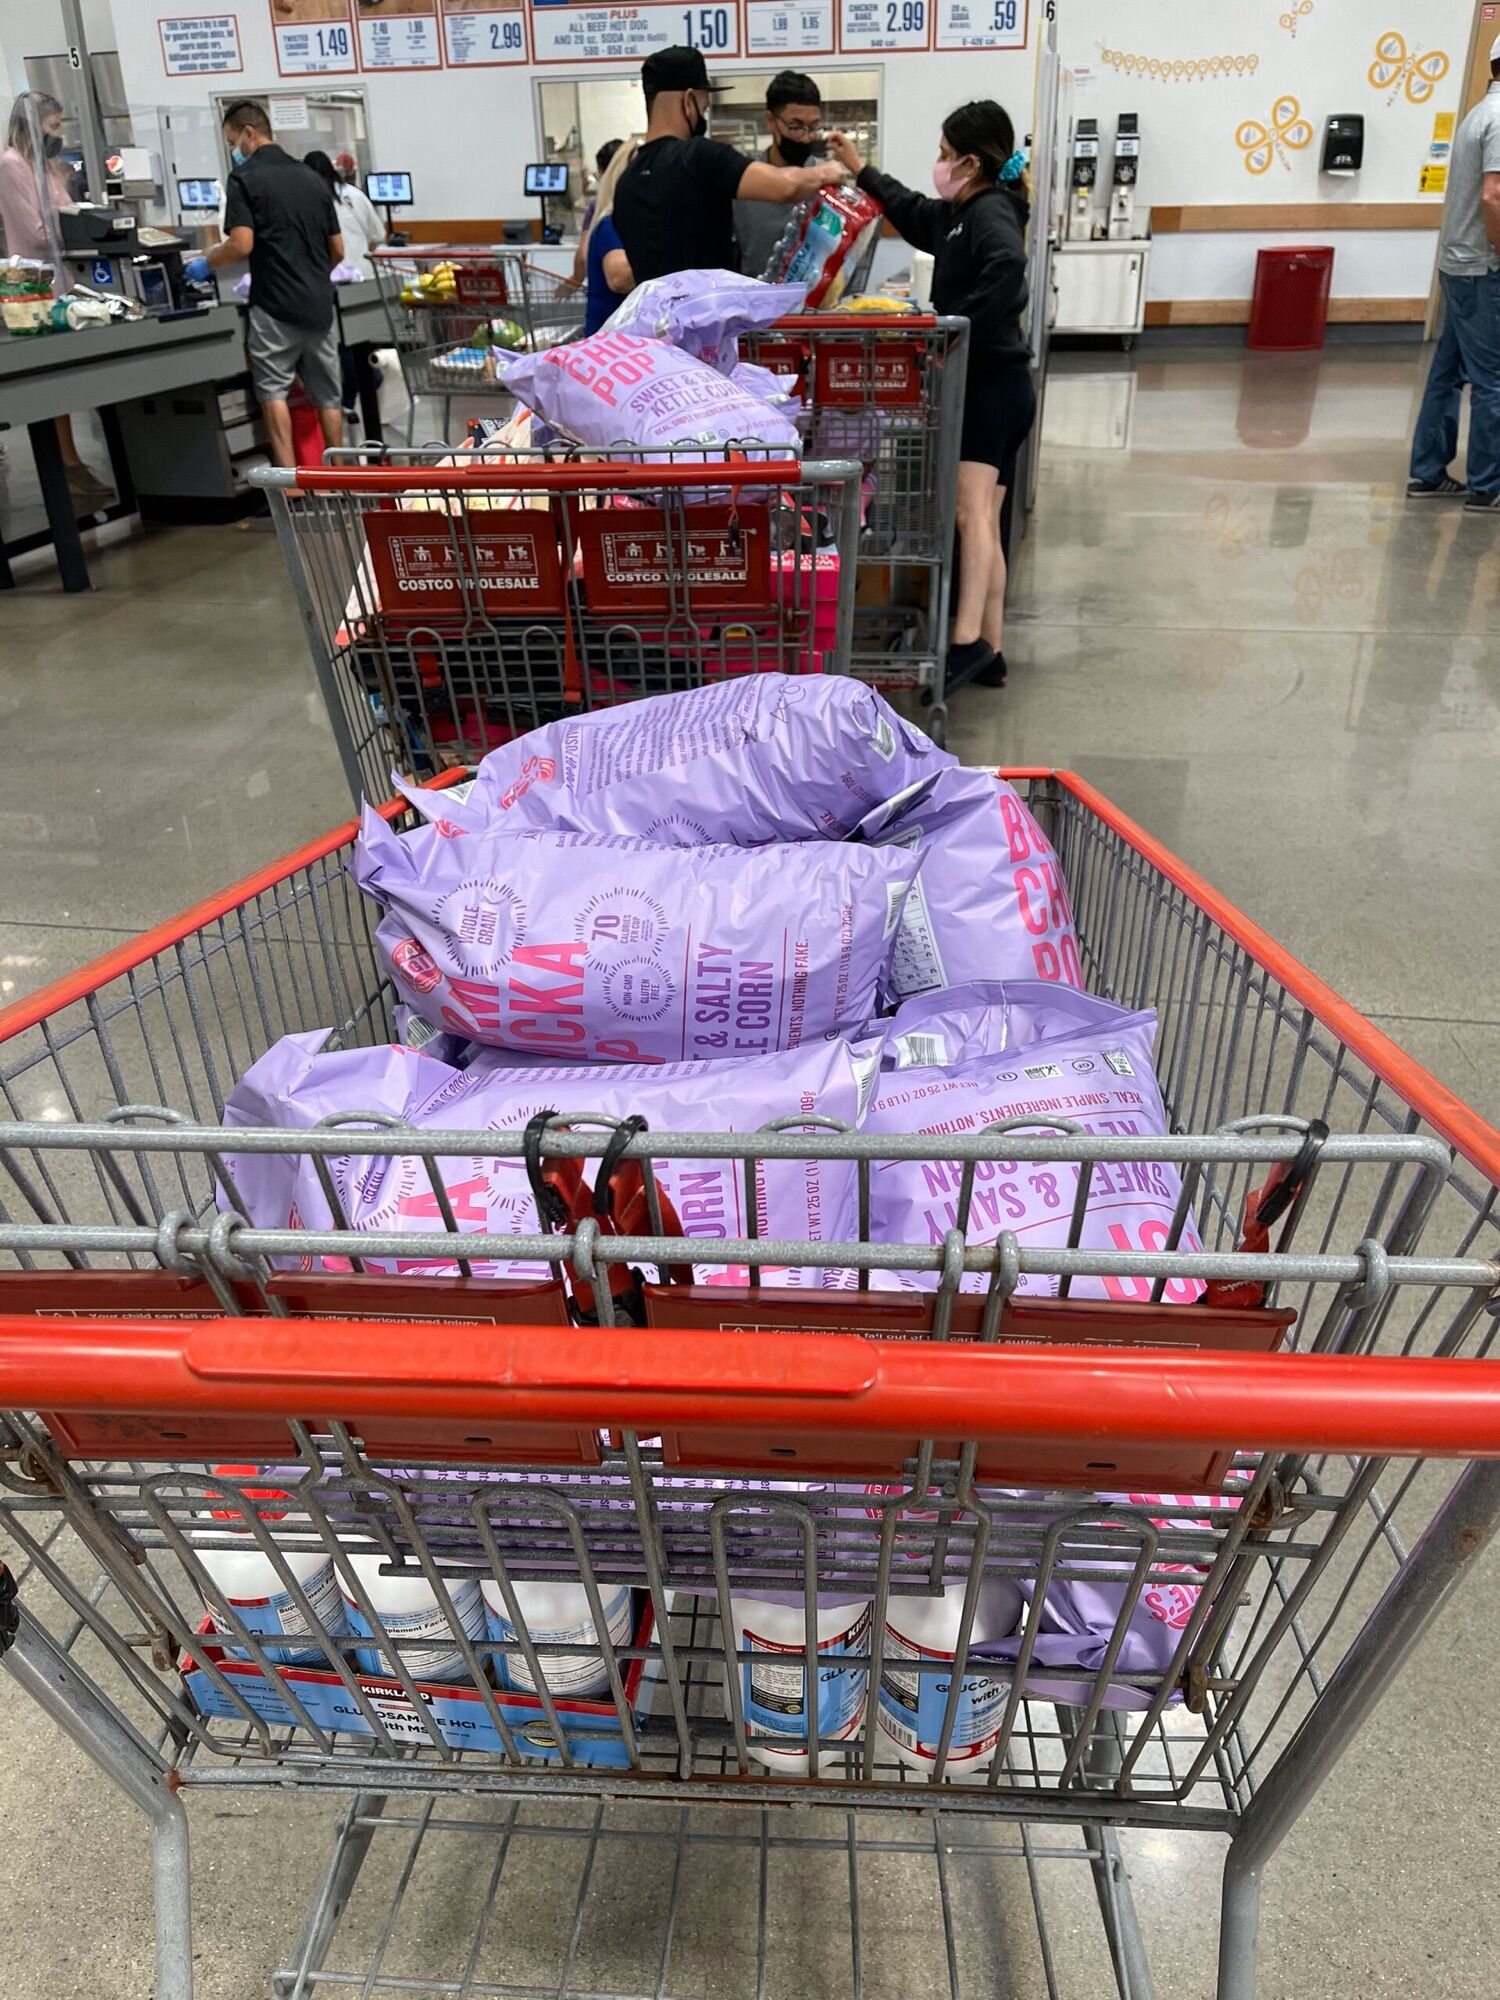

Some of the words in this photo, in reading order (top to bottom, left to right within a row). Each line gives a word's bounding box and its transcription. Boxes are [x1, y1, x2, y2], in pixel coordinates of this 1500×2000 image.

[610, 9, 638, 19] PLUS
[887, 2, 924, 32] 2.99
[1046, 1, 1055, 22] 6
[490, 22, 522, 49] 2.99
[569, 22, 584, 32] ALL
[587, 22, 607, 32] BEEF
[610, 20, 626, 30] HOT
[630, 20, 648, 30] DOG
[683, 9, 728, 49] 1.50
[316, 27, 348, 56] 1.49
[601, 34, 624, 43] SODA
[70, 48, 80, 68] 5
[592, 351, 656, 408] POP
[630, 377, 681, 414] SWEET
[683, 374, 698, 386] &
[651, 386, 708, 417] KETTLE
[398, 578, 454, 591] COSTCO
[606, 573, 661, 582] COSTCO
[458, 904, 480, 945] WHOLE
[477, 906, 498, 946] GRAIN
[592, 915, 620, 942] 70
[620, 914, 632, 944] CALORIES
[630, 916, 641, 929] CUP
[630, 930, 640, 943] PER
[794, 938, 809, 969] FAKE.
[623, 974, 634, 1006] NON-GMO
[640, 979, 650, 1004] GLUTEN
[650, 983, 660, 1000] FREE
[694, 942, 732, 1024] SALTY
[791, 970, 808, 1012] NOTHING
[736, 961, 774, 1030] CORN
[694, 1031, 729, 1049] &
[914, 1086, 928, 1098] OZ
[928, 1085, 940, 1096] 25
[942, 1082, 958, 1092] WT
[878, 1100, 885, 1110] 9
[887, 1095, 898, 1108] LB
[1068, 1092, 1110, 1108] SIMPLE
[1109, 1091, 1142, 1105] REAL,
[974, 1096, 1063, 1124] INGREDIENTS.
[807, 1180, 820, 1195] OZ
[1028, 1172, 1060, 1208] &
[680, 1170, 727, 1238] ORN
[808, 1196, 820, 1210] 25
[808, 1213, 821, 1228] WT
[971, 1686, 1000, 1704] with
[334, 1706, 446, 1726] GLUOSAME
[385, 1722, 403, 1731] ith
[408, 1726, 442, 1735] MS
